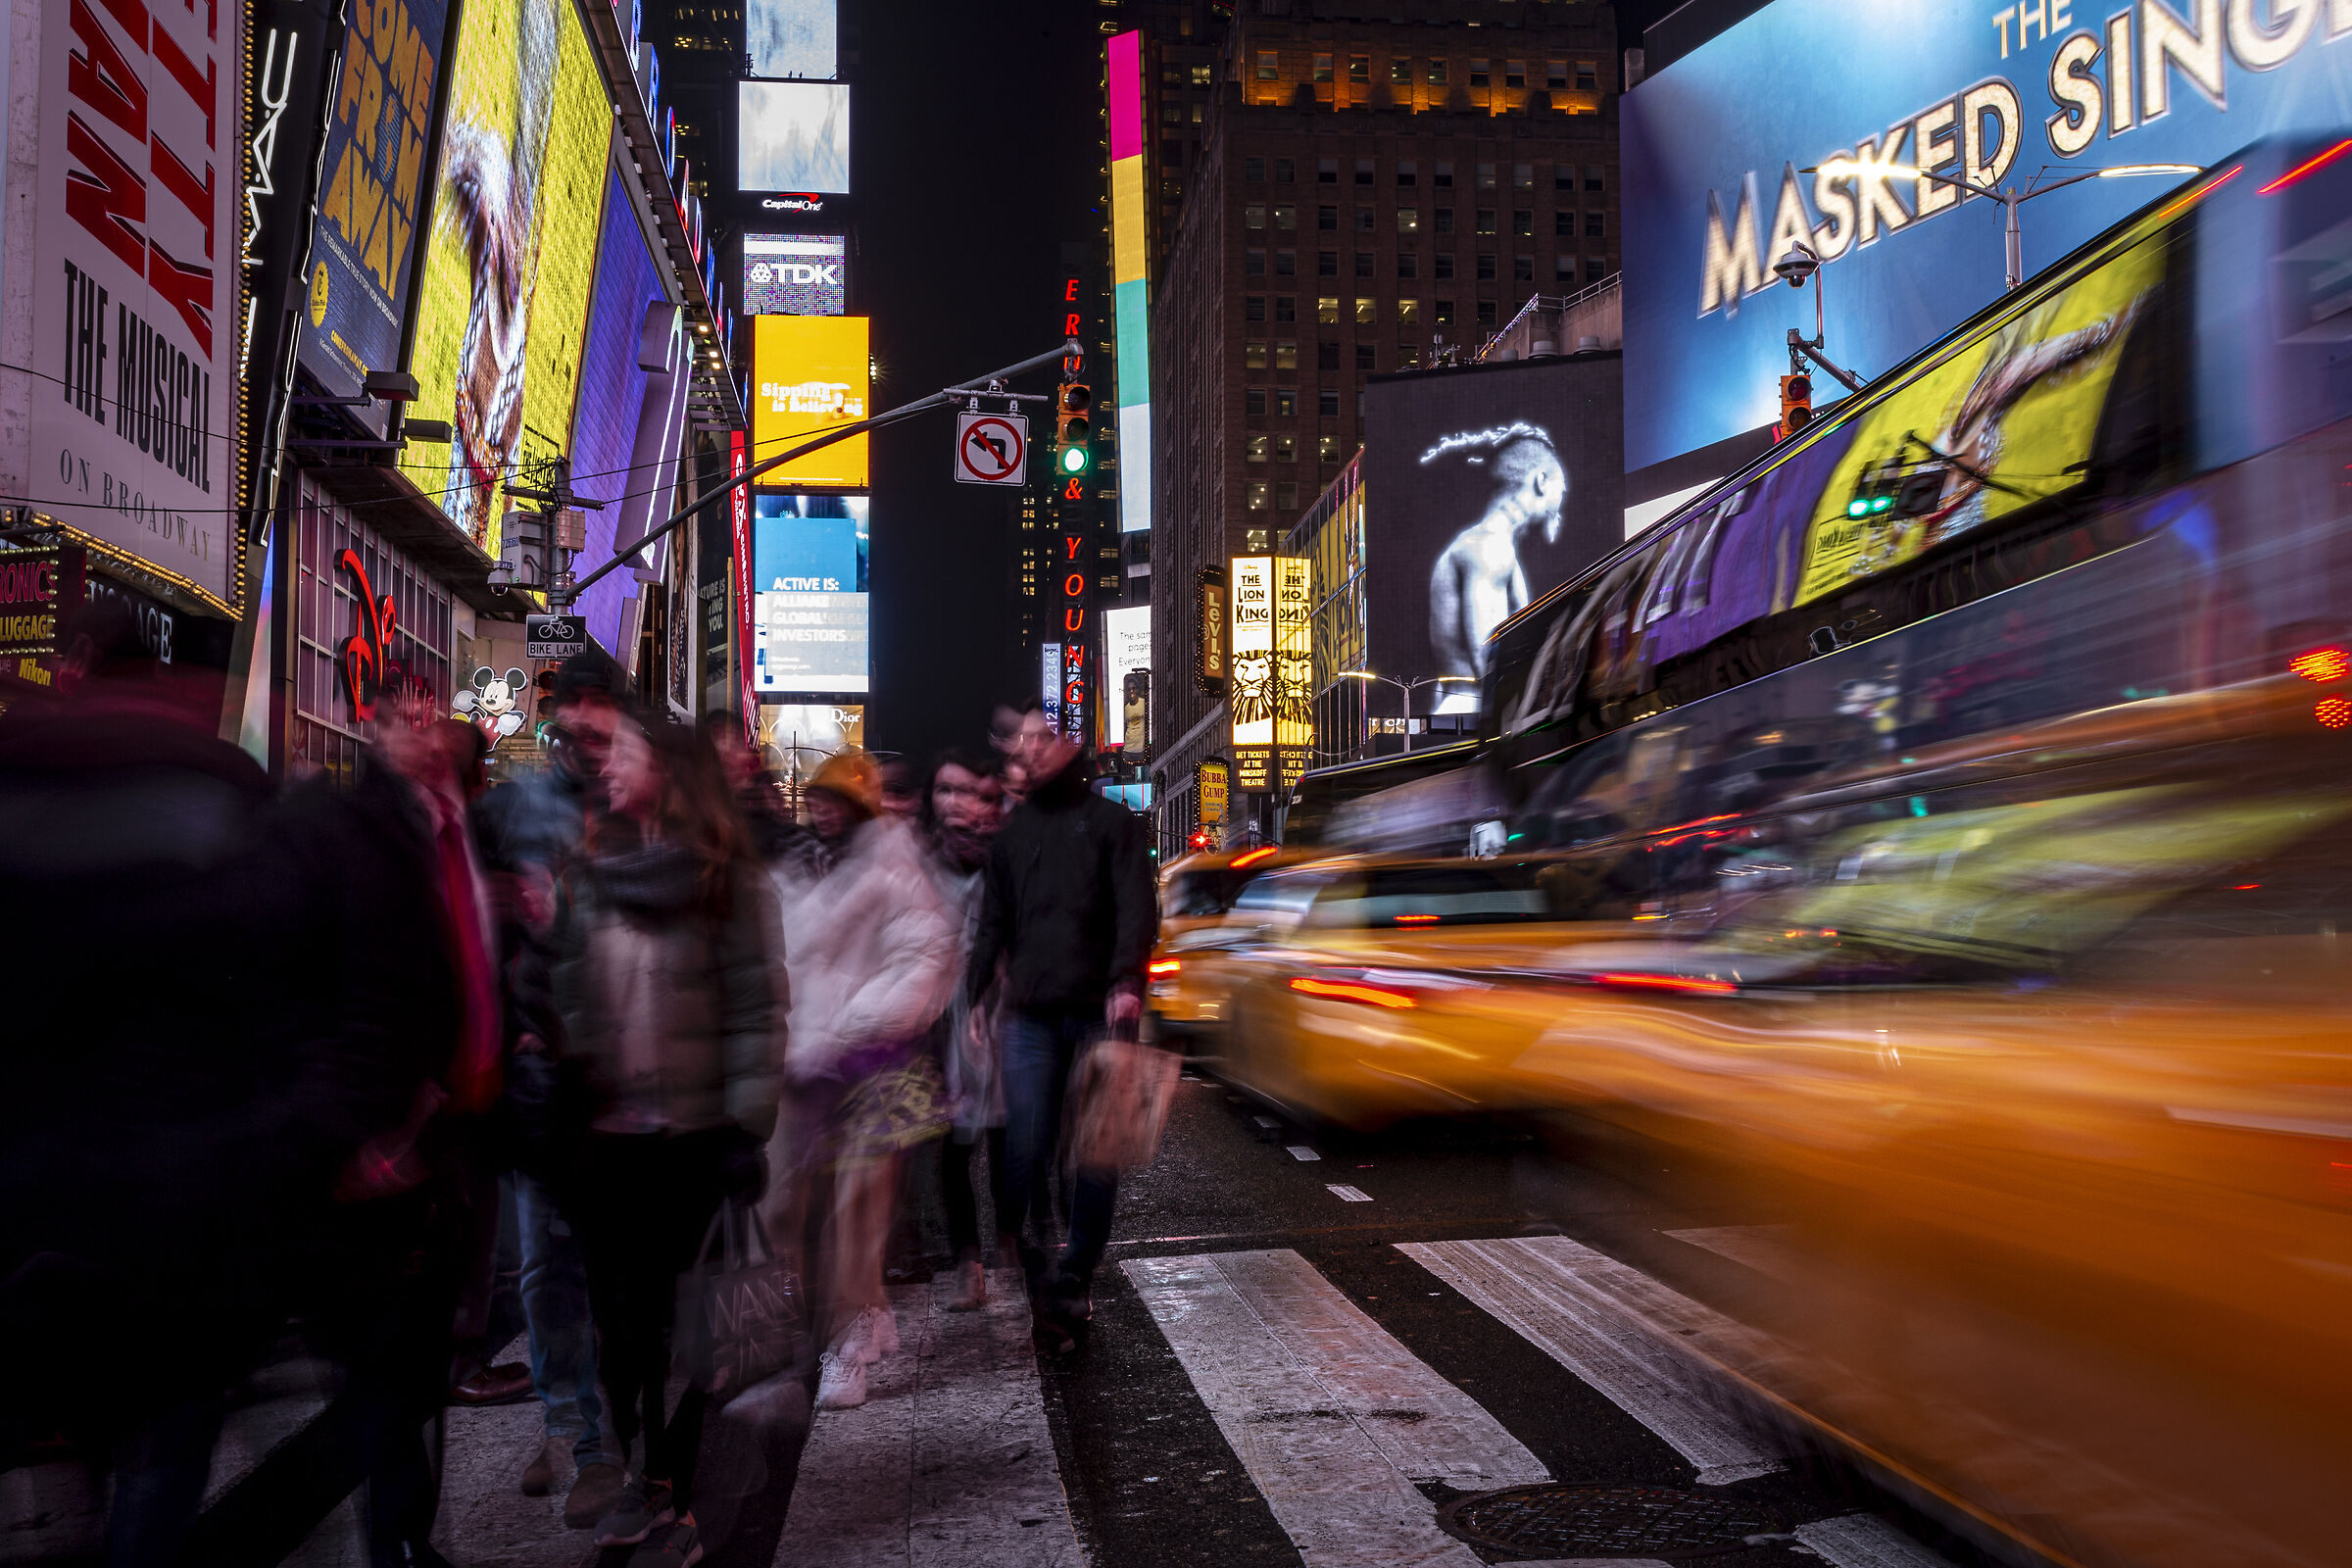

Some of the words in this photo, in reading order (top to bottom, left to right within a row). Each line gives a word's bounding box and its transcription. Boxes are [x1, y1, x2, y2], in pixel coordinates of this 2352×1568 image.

[1992, 0, 2074, 60] THE
[338, 27, 423, 222] FROM
[1697, 75, 2025, 320] MASKED
[322, 137, 412, 302] AWAY
[769, 263, 838, 285] TDK
[64, 258, 109, 426] THE
[116, 301, 211, 495] MUSICAL
[760, 382, 831, 402] Sipping
[789, 399, 863, 416] Believng
[1064, 477, 1083, 500] &
[60, 449, 91, 495] ON
[103, 471, 210, 563] BROADWAY
[773, 577, 820, 590] ACTIVE
[823, 577, 840, 591] IS:
[1242, 575, 1260, 584] THE
[1239, 587, 1264, 603] LION
[772, 612, 824, 624] GLOBAL
[1064, 537, 1085, 704] YOUNG
[1236, 605, 1269, 623] KING
[772, 628, 847, 642] INVESTORS
[530, 643, 552, 655] BIKE
[19, 658, 52, 687] Nikon
[830, 708, 860, 723] Dior
[1236, 751, 1247, 760] GET
[1248, 750, 1270, 760] TICKETS
[1201, 769, 1227, 783] BUBBA
[1241, 778, 1265, 787] THEATRE
[1203, 785, 1225, 799] GUMP
